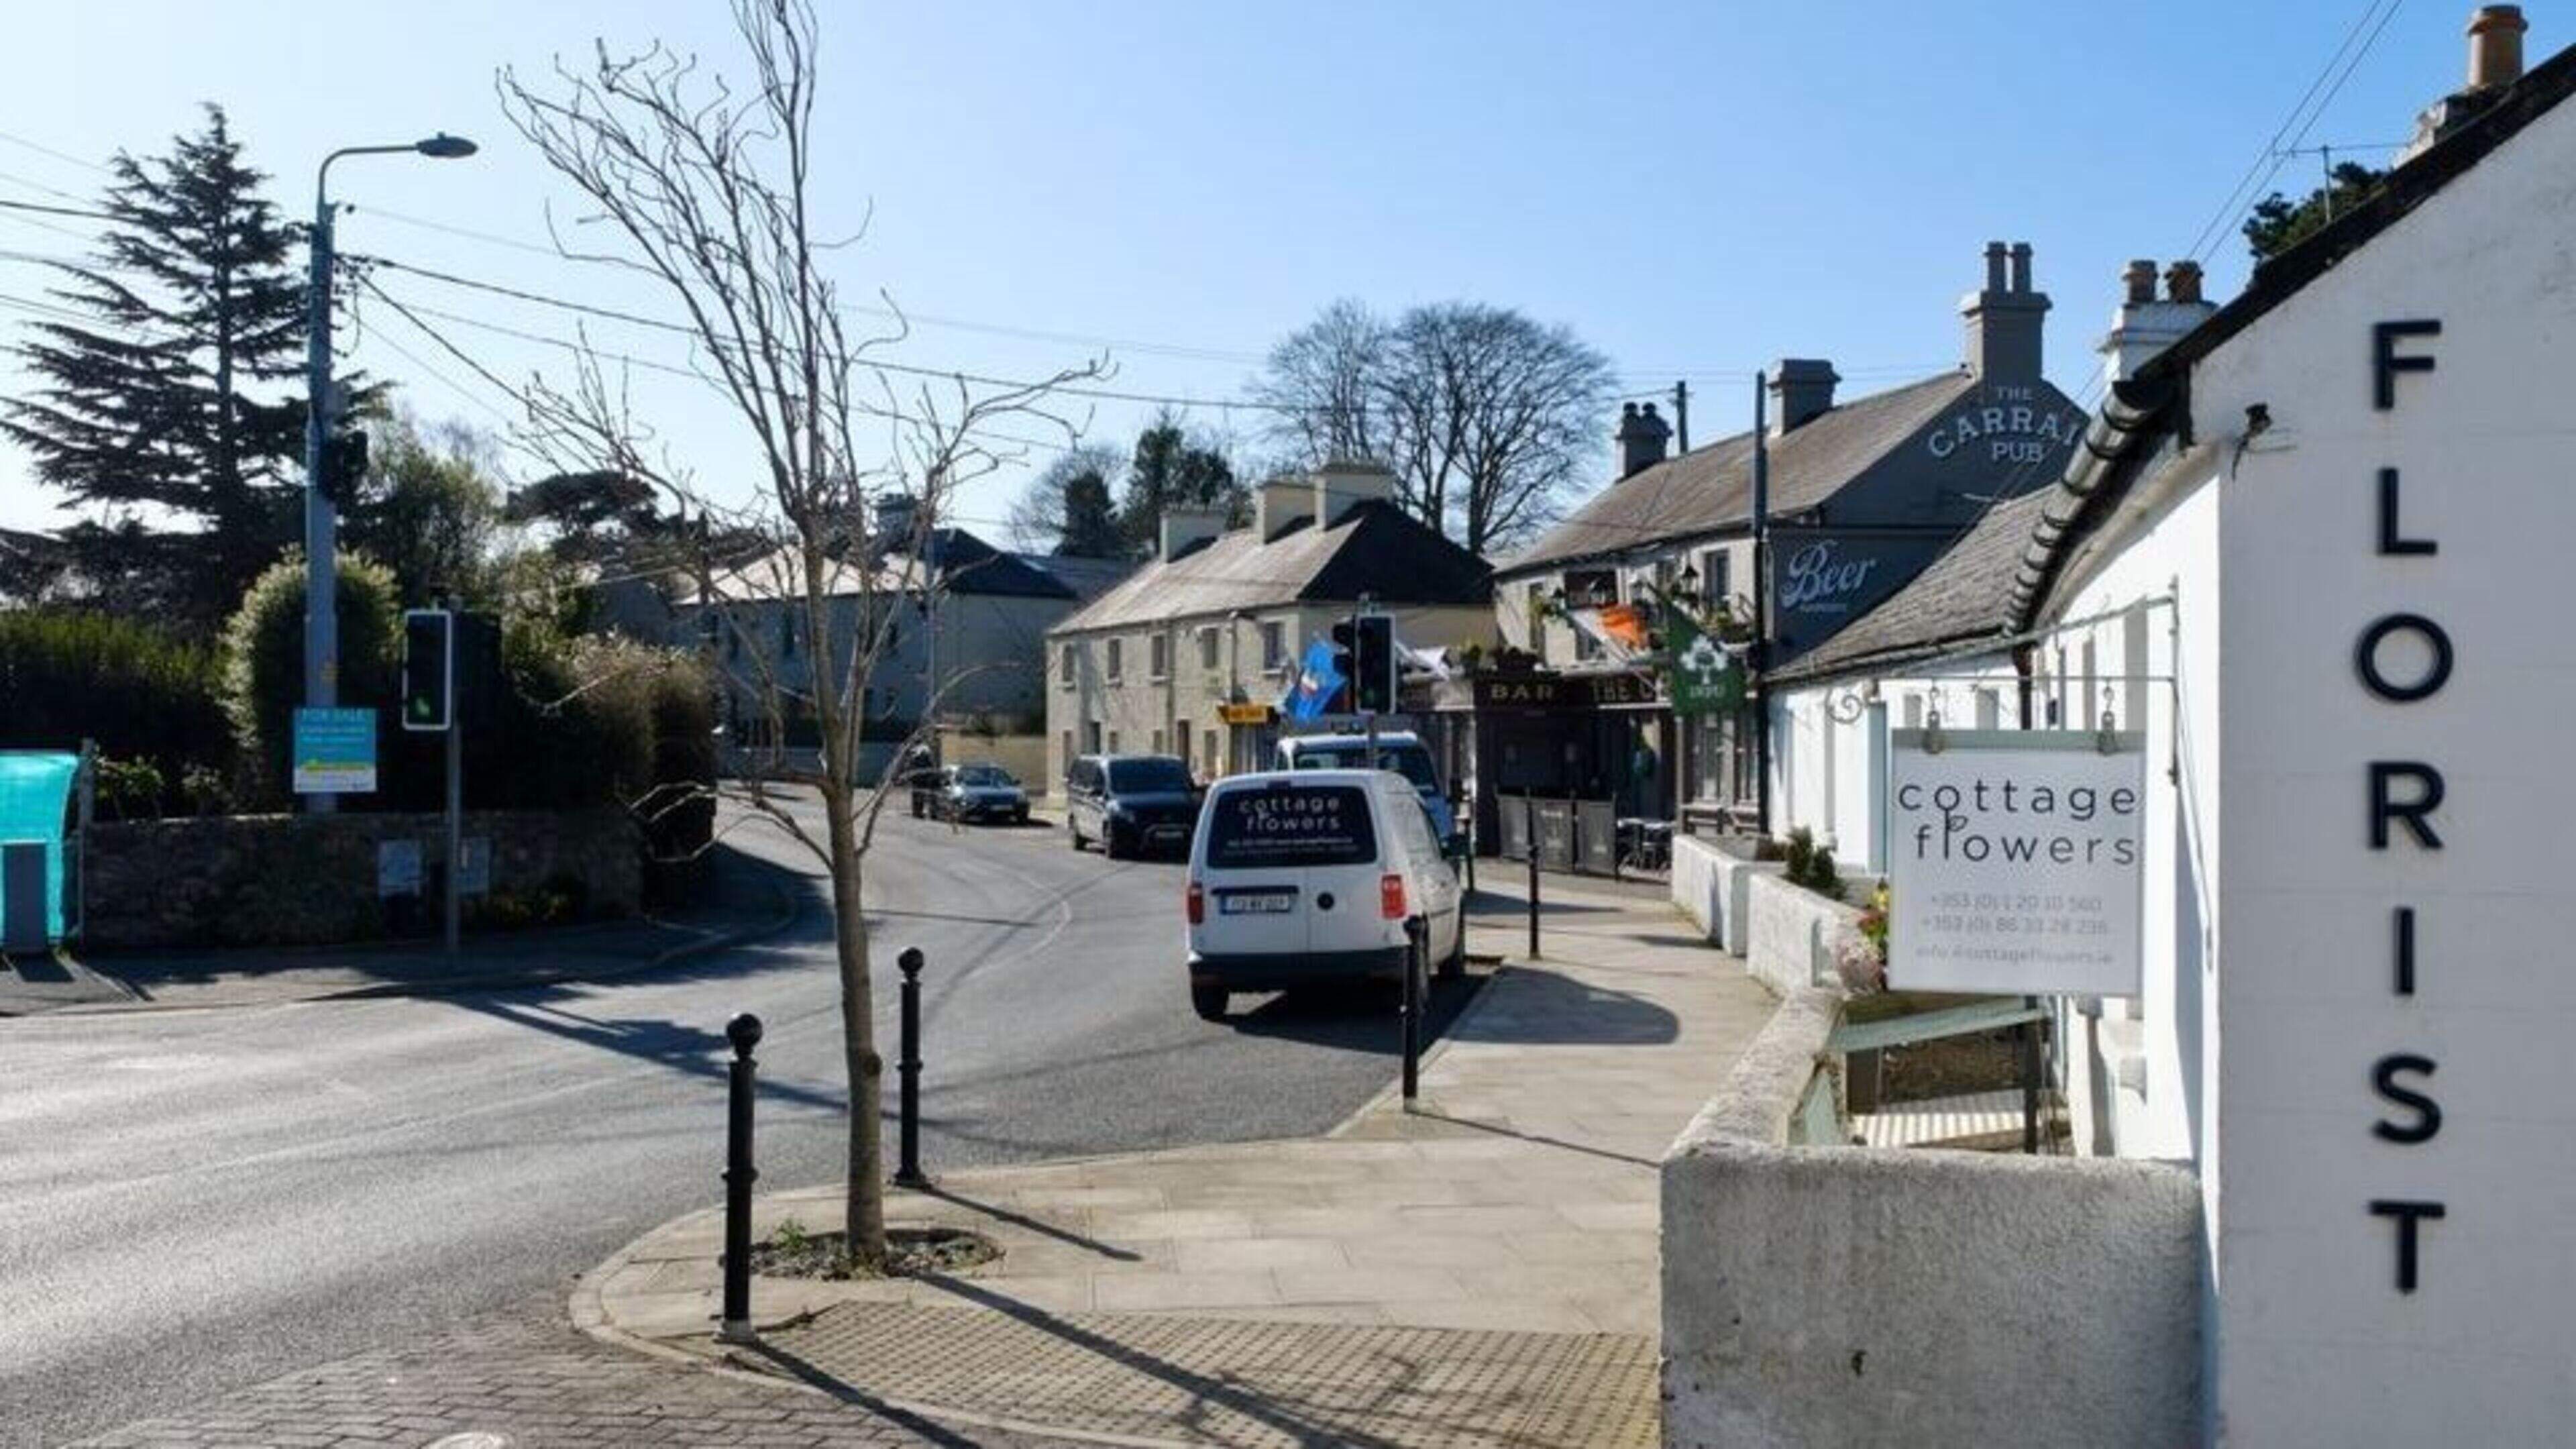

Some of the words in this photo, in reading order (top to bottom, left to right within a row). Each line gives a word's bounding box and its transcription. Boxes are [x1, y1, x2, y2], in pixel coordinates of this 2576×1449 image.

[1998, 386, 2033, 400] THE
[1929, 406, 2080, 458] CARRAI
[1992, 441, 2045, 464] PUB
[1778, 539, 1876, 609] Beer
[1491, 682, 1554, 700] BAR
[1238, 796, 1341, 813] cottage
[1898, 779, 2135, 821] cottage
[2353, 319, 2453, 1295] FLORIST
[1246, 814, 1341, 831] flowers
[1914, 818, 2135, 865] flowers
